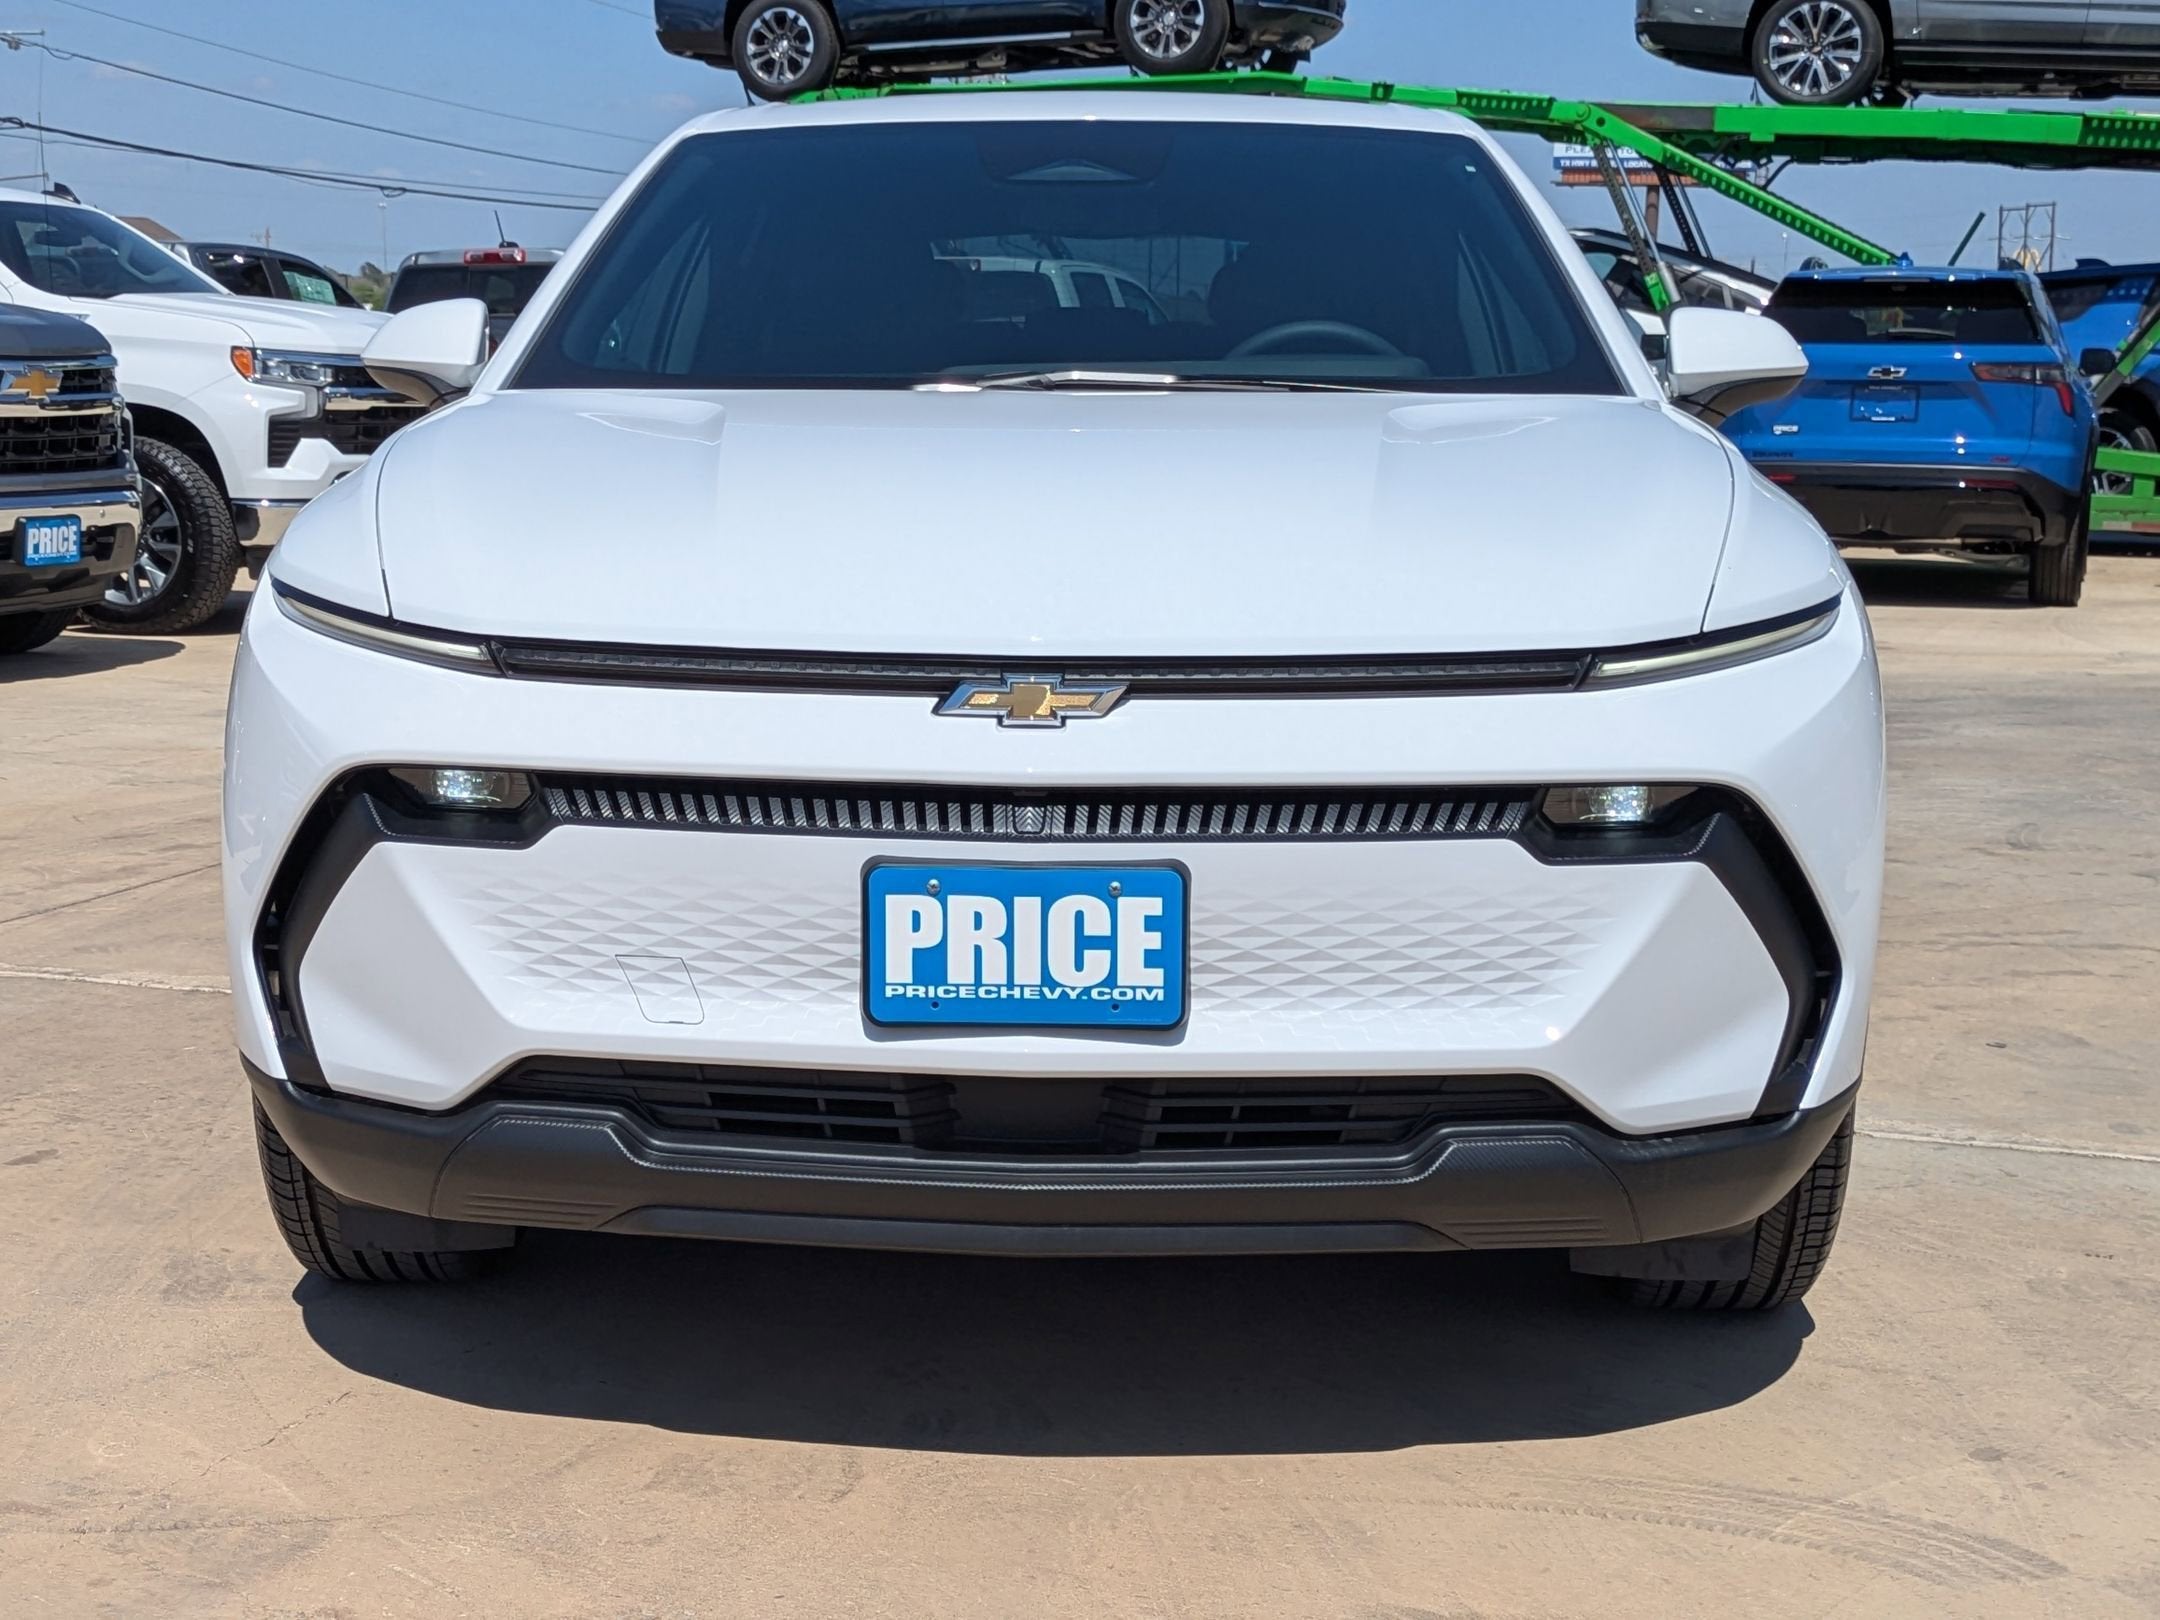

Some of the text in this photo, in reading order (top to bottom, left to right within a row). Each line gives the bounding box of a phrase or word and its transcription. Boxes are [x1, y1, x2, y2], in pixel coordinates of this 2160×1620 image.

[27, 525, 78, 555] PRICE
[885, 894, 1164, 987] PRICE
[885, 983, 1164, 1001] PRICECHEVY.COM
